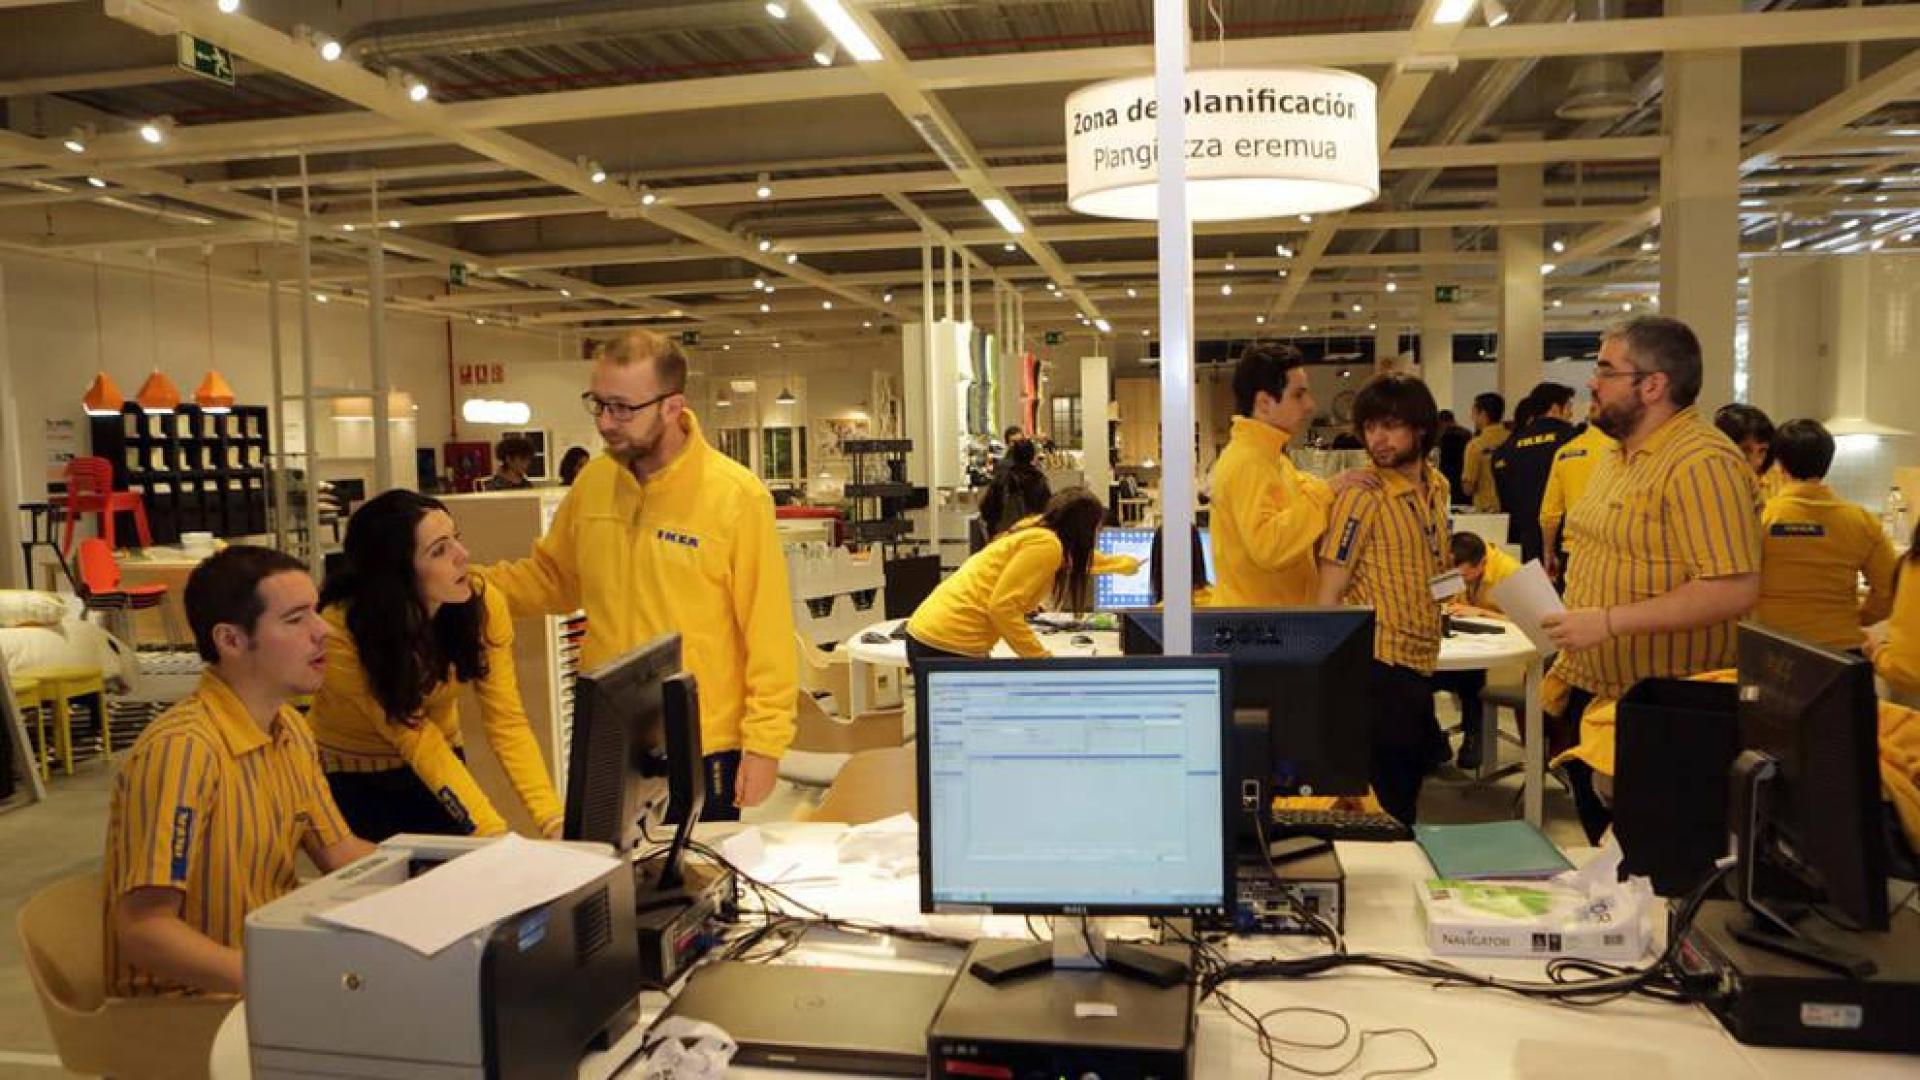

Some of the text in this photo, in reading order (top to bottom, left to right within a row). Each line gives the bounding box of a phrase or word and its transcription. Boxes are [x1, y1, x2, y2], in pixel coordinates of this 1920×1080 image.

[1073, 107, 1118, 135] Zona
[1127, 97, 1158, 122] de
[1234, 138, 1338, 160] eremua
[657, 529, 699, 548] IKEA
